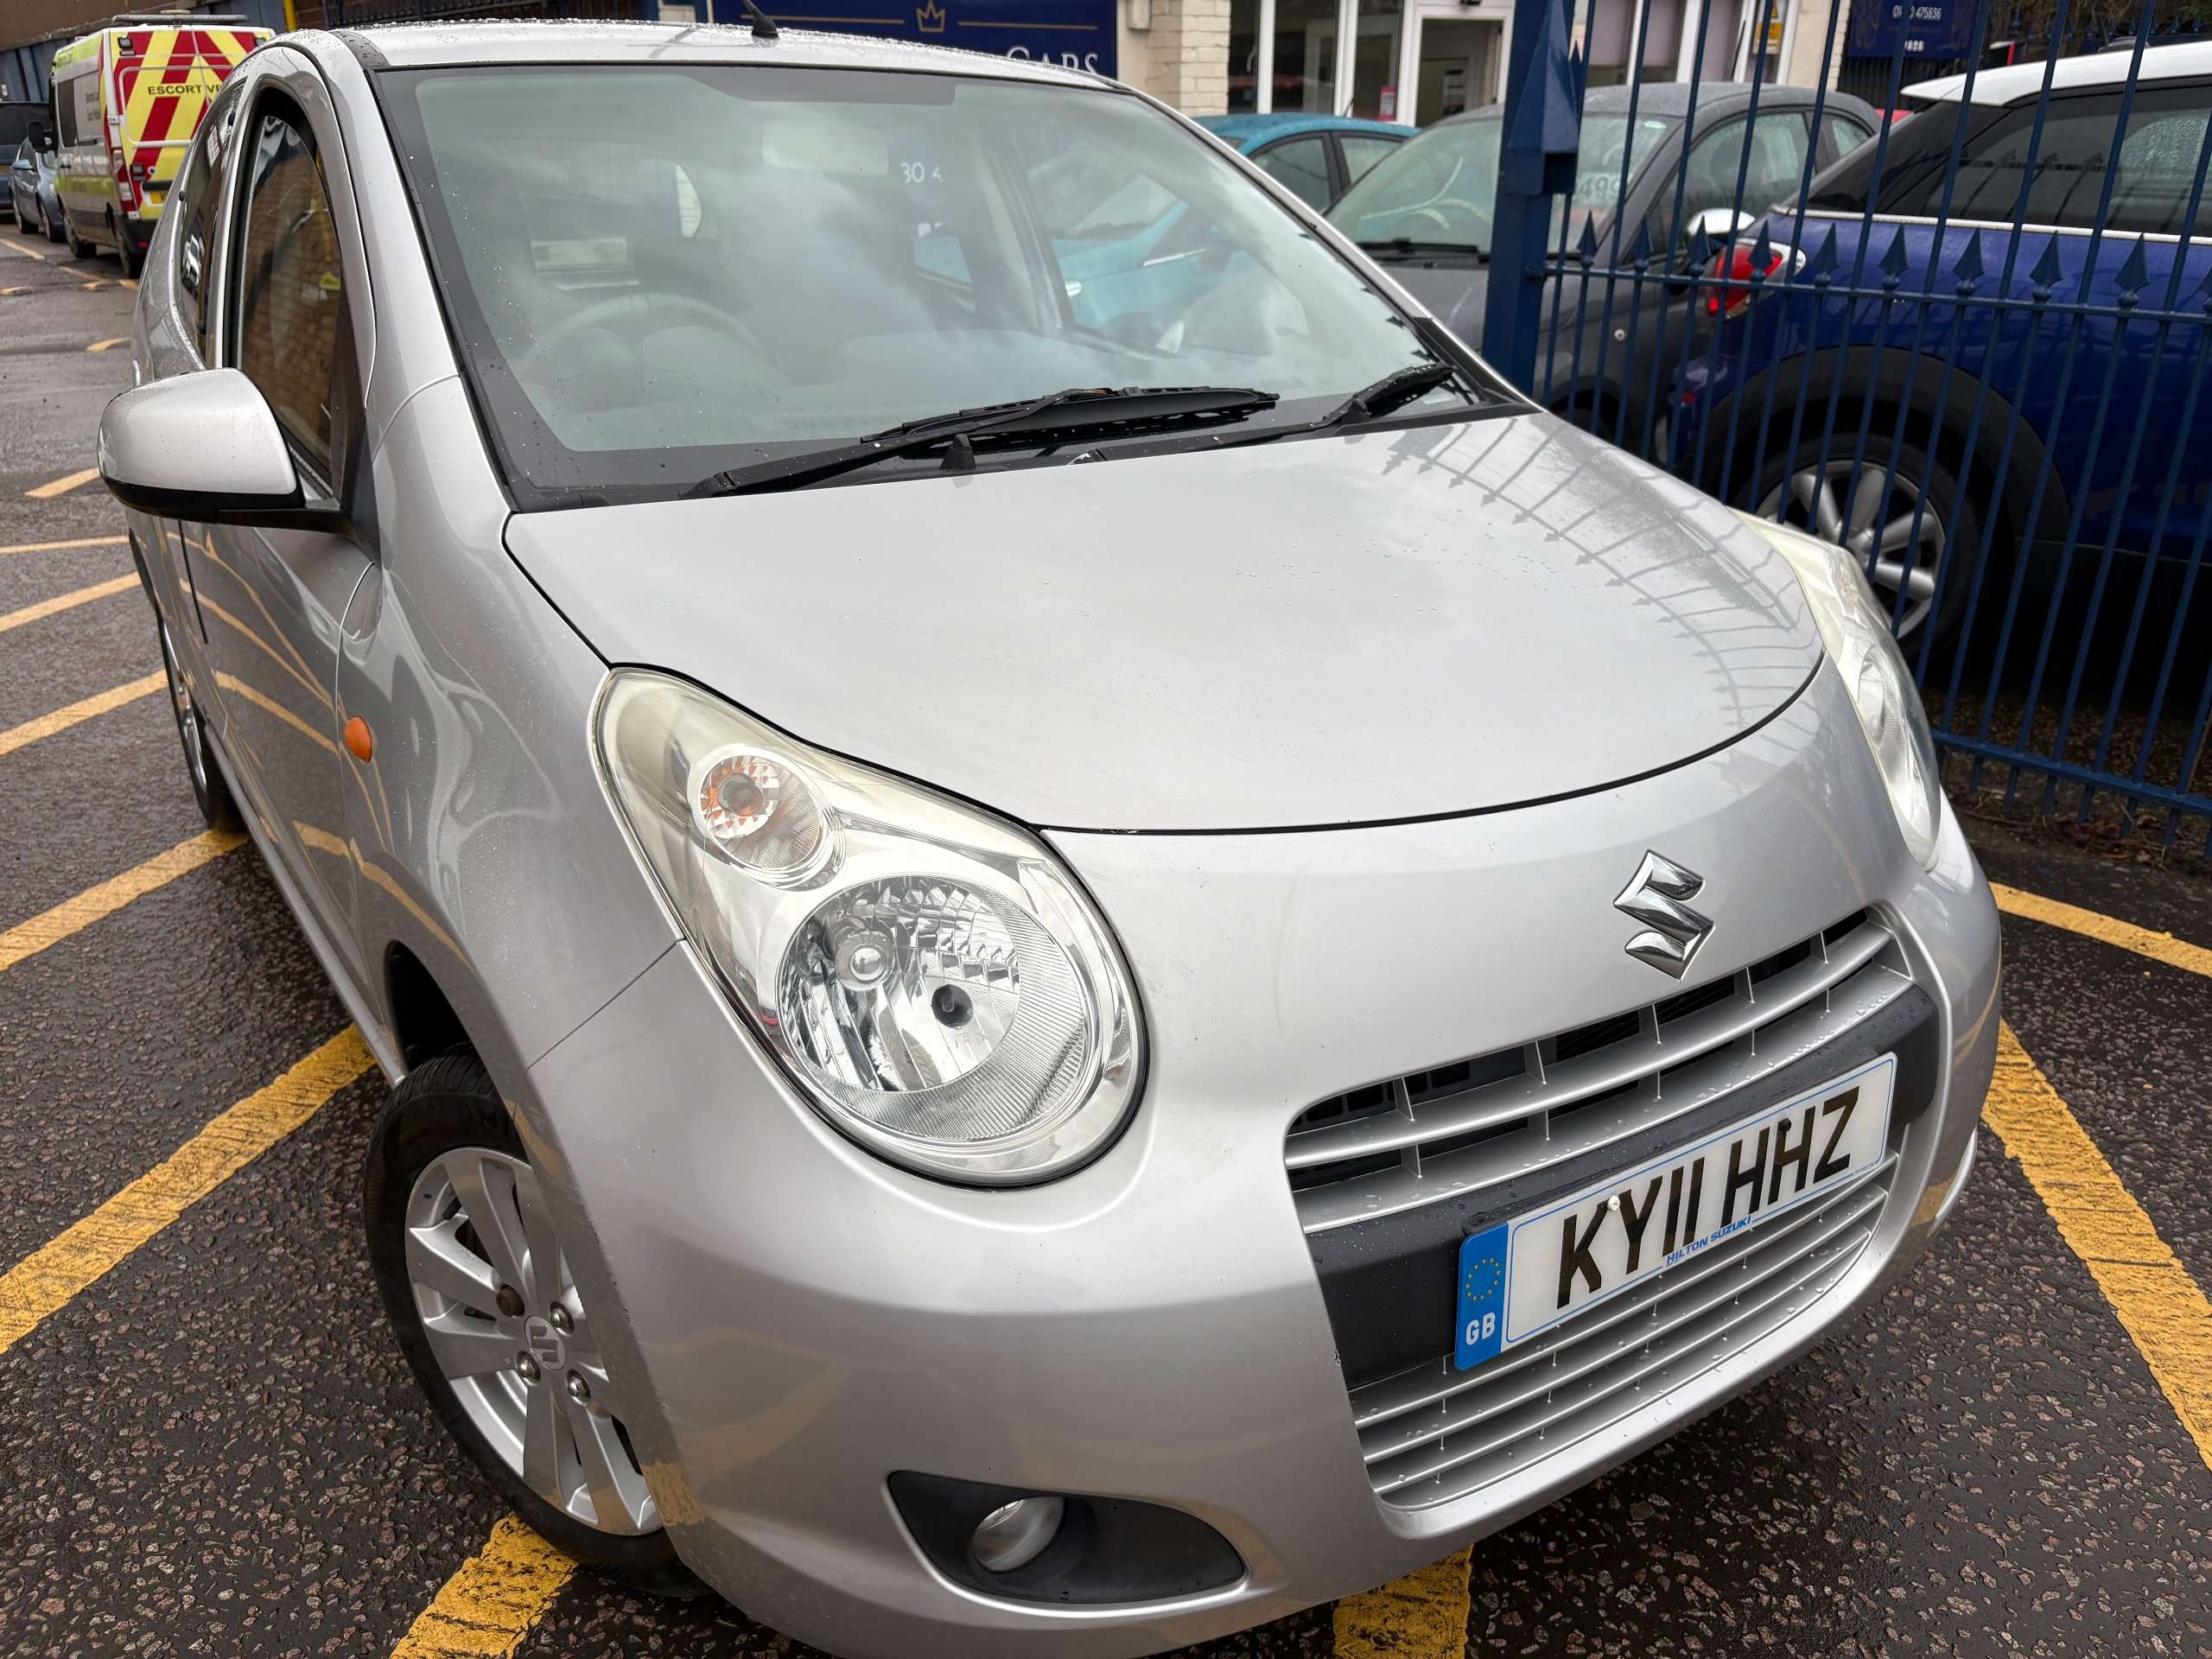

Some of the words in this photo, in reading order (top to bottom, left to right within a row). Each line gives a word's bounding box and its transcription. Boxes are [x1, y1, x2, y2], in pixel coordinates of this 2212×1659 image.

[148, 85, 202, 95] ESCORT
[1556, 1156, 1705, 1309] KY11
[1720, 1085, 1860, 1229] HHZ
[1666, 1236, 1708, 1263] HILTON
[1711, 1216, 1751, 1242] SUZUKI
[1465, 1312, 1496, 1345] GB
